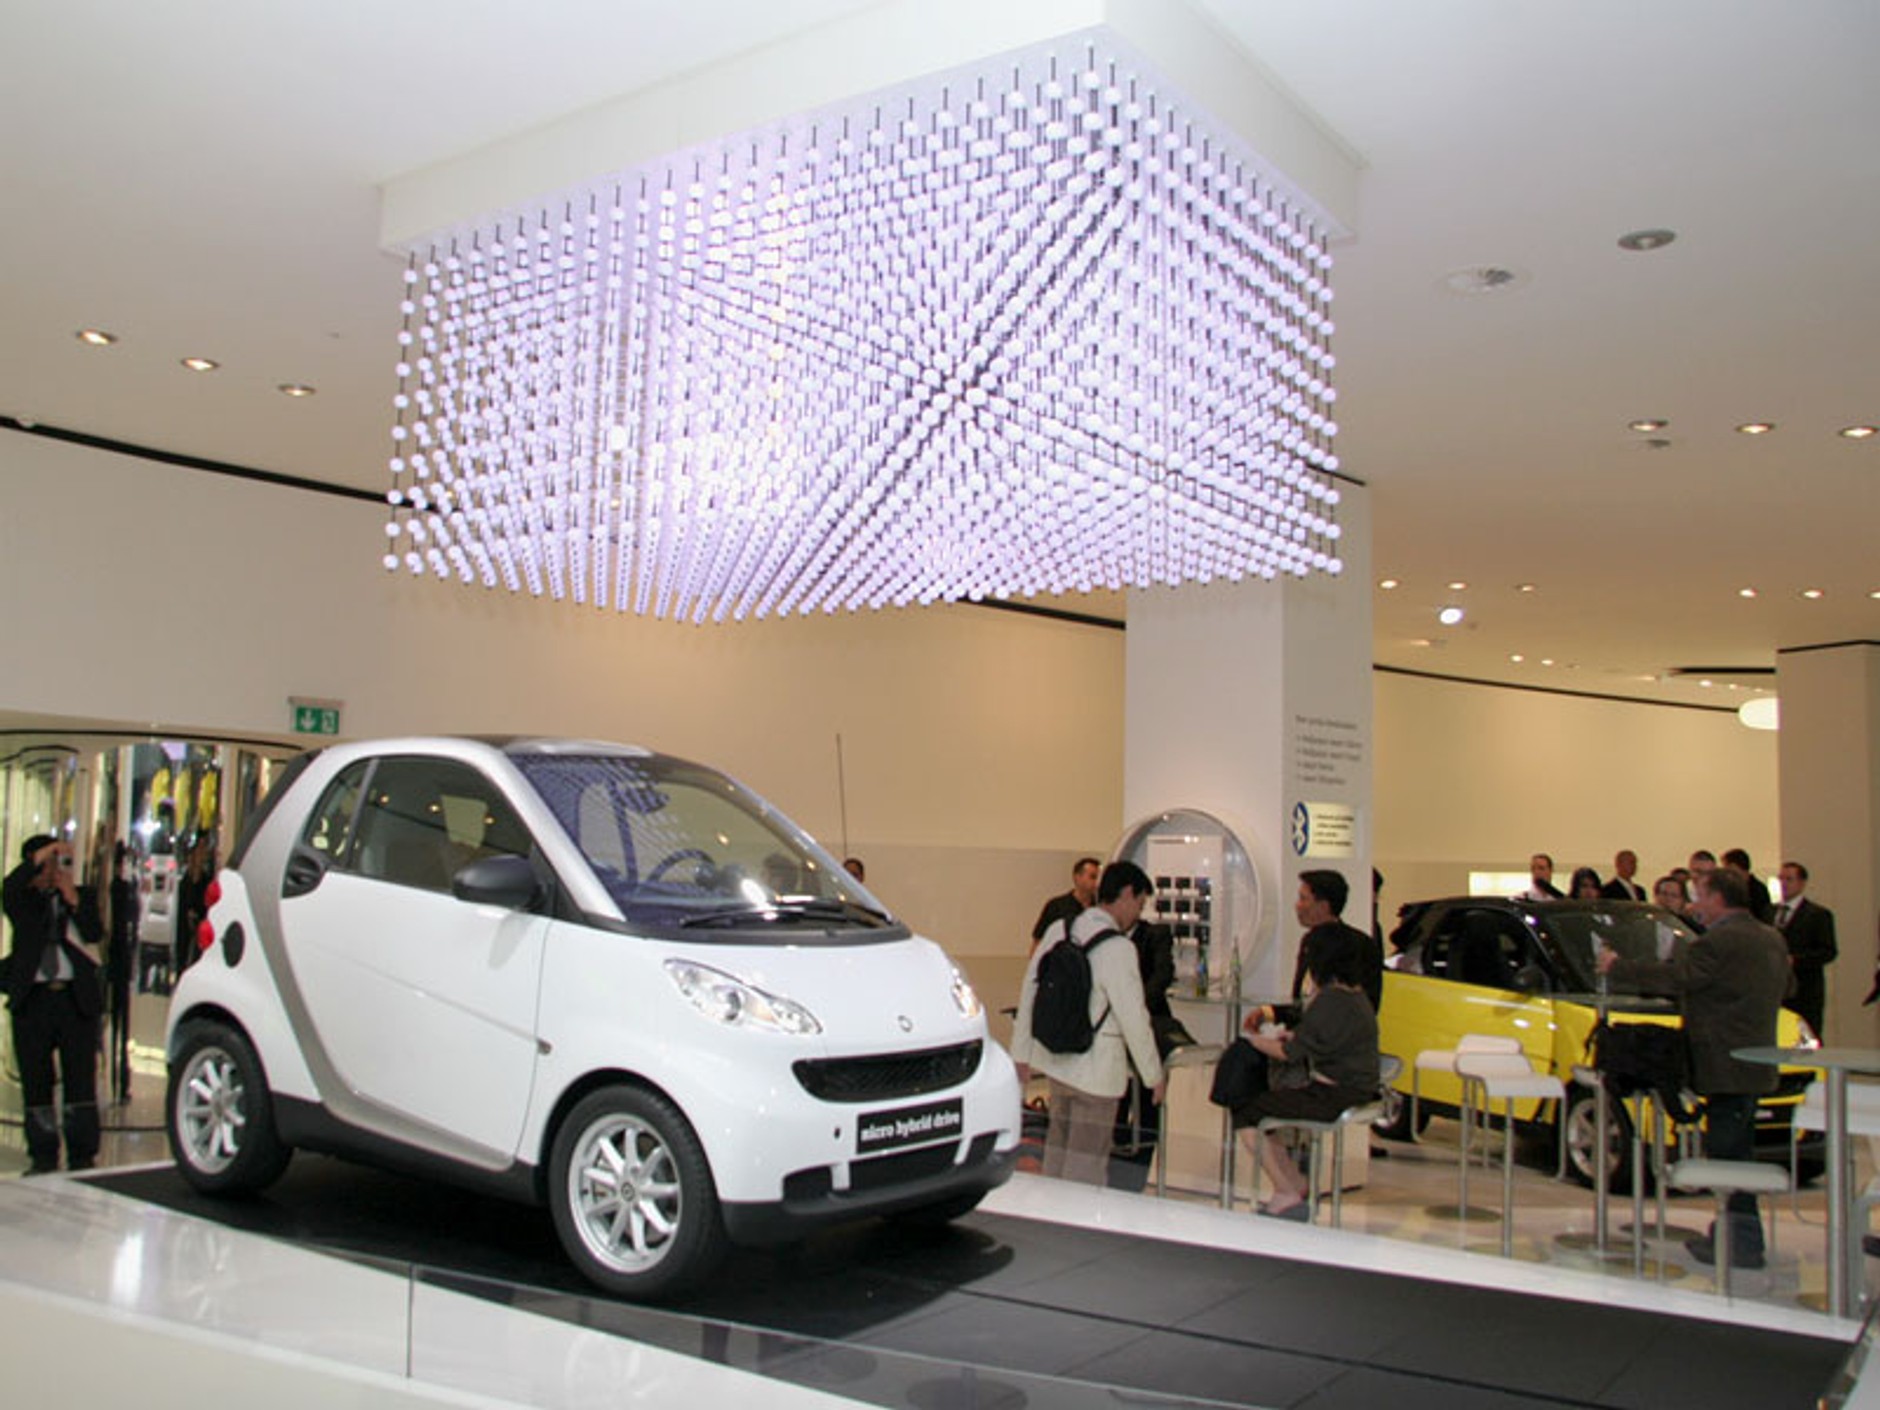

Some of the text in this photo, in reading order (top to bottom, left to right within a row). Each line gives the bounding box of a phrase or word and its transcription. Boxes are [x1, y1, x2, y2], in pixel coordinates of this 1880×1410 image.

[861, 1110, 960, 1141] micro hybrid drive
